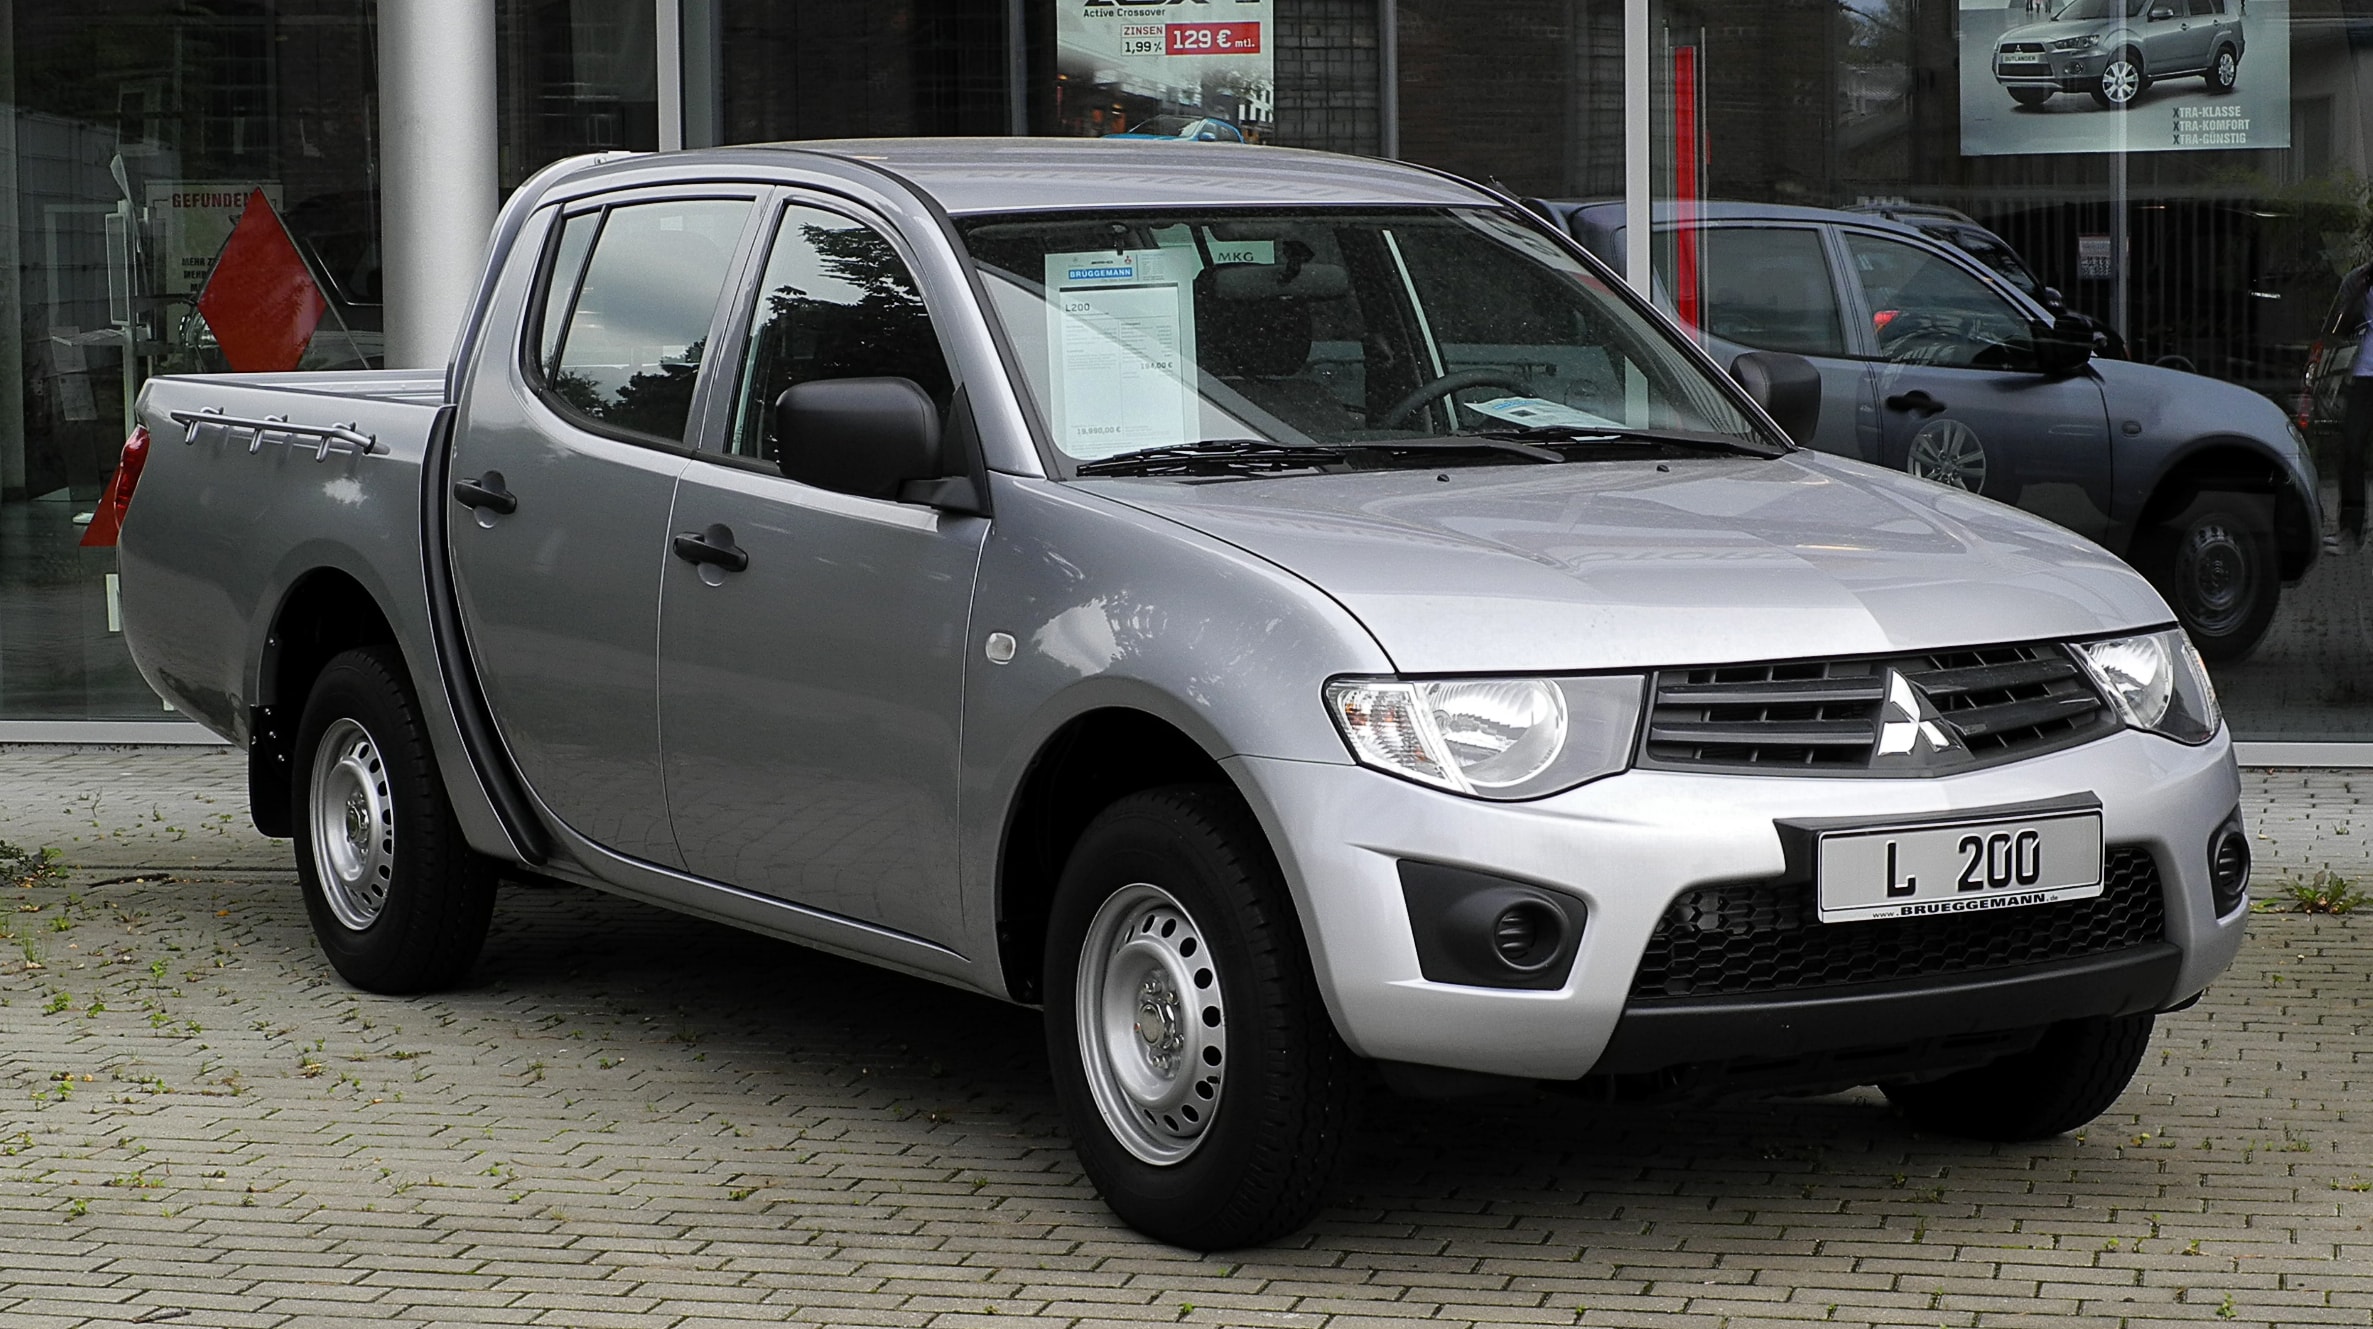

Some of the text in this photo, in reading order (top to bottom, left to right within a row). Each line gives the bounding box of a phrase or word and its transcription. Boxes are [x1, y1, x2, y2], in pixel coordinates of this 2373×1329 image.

[1083, 8, 1166, 18] Active Crossover
[1123, 26, 1163, 35] ZINSEN
[1173, 29, 1256, 48] 129 € mtl.
[2172, 106, 2241, 118] XTRA-KLASSE
[2172, 119, 2250, 131] XTRA-KOMFORT
[2172, 132, 2247, 144] XTRA-GÜNSTIG
[1217, 252, 1254, 262] MKG
[1069, 269, 1131, 278] BRÜGGEMANN
[1065, 303, 1090, 312] L200
[1886, 830, 2040, 897] L 200
